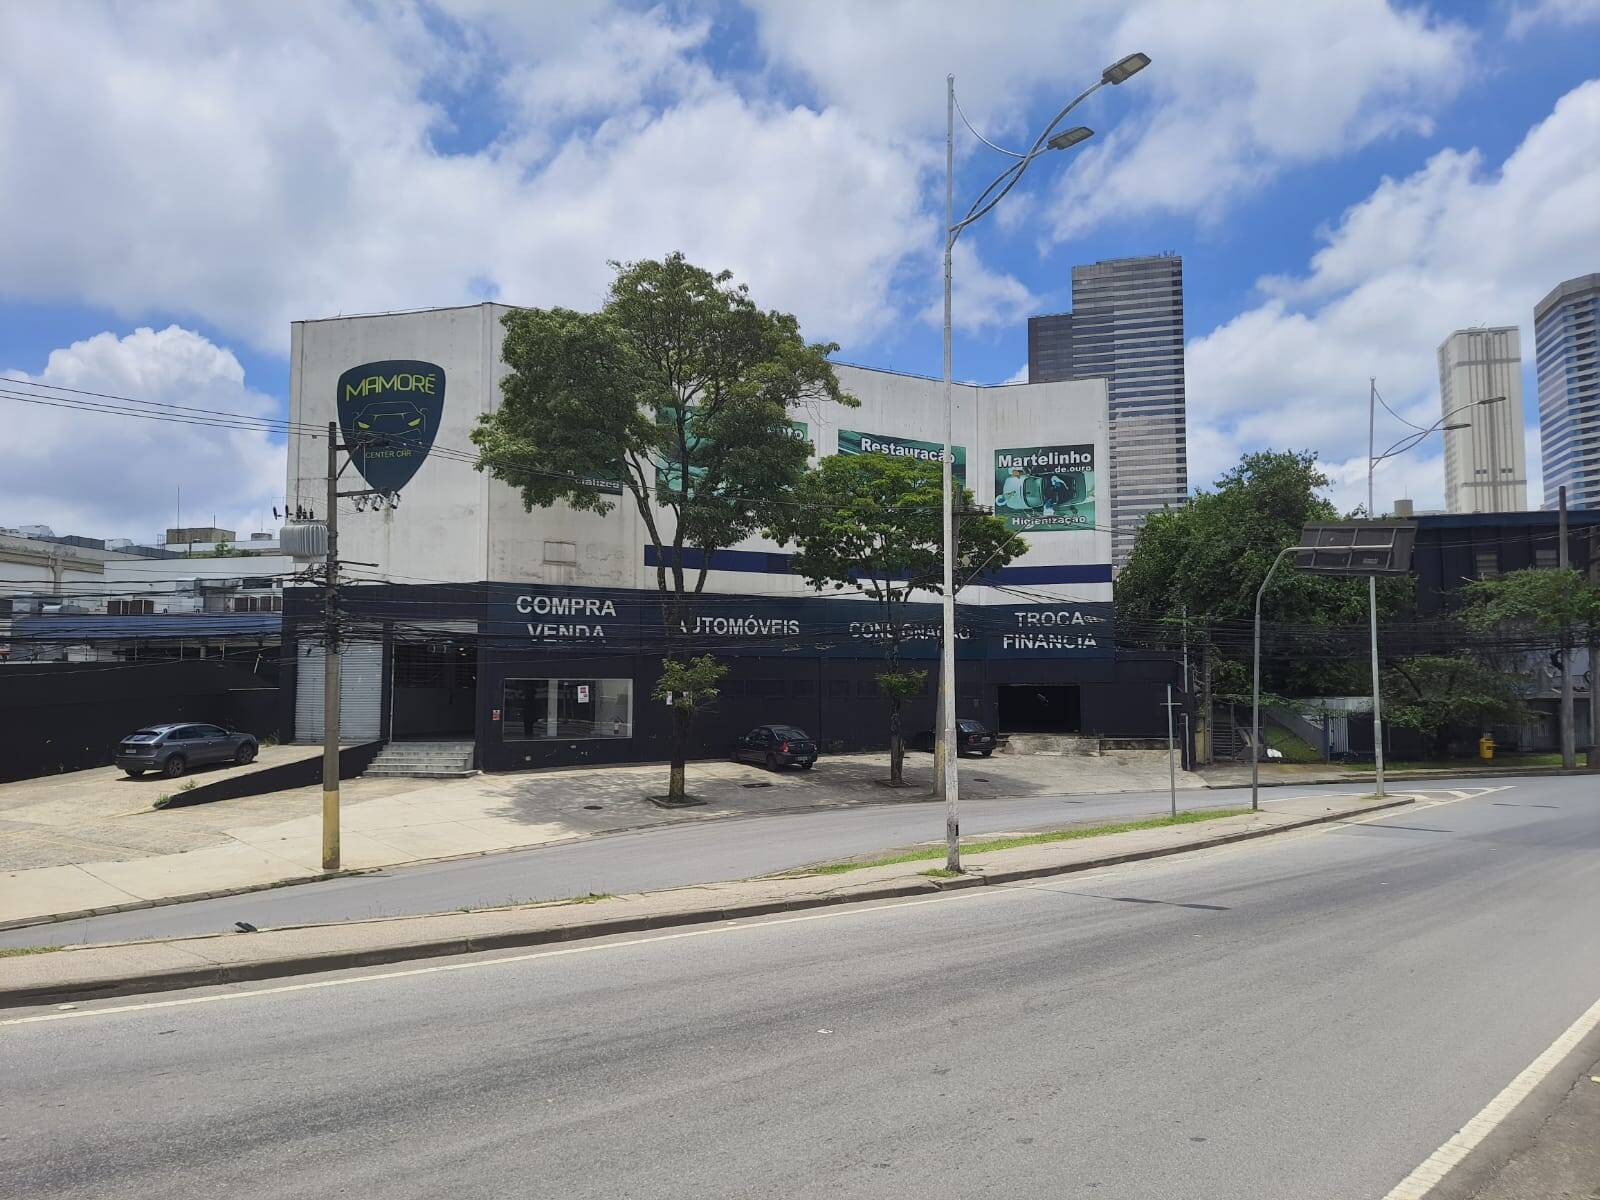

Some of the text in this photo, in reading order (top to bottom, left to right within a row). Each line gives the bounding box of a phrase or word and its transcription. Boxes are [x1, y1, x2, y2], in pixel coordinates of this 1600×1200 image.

[346, 373, 436, 401] MAMORÉ
[365, 450, 394, 459] CENTER
[998, 451, 1092, 468] Martelinho
[1069, 465, 1092, 473] ouro
[516, 595, 617, 616] COMPRA
[1014, 611, 1086, 627] TROCA
[527, 623, 607, 643] VENDA
[1003, 633, 1099, 649] FINANCIA
